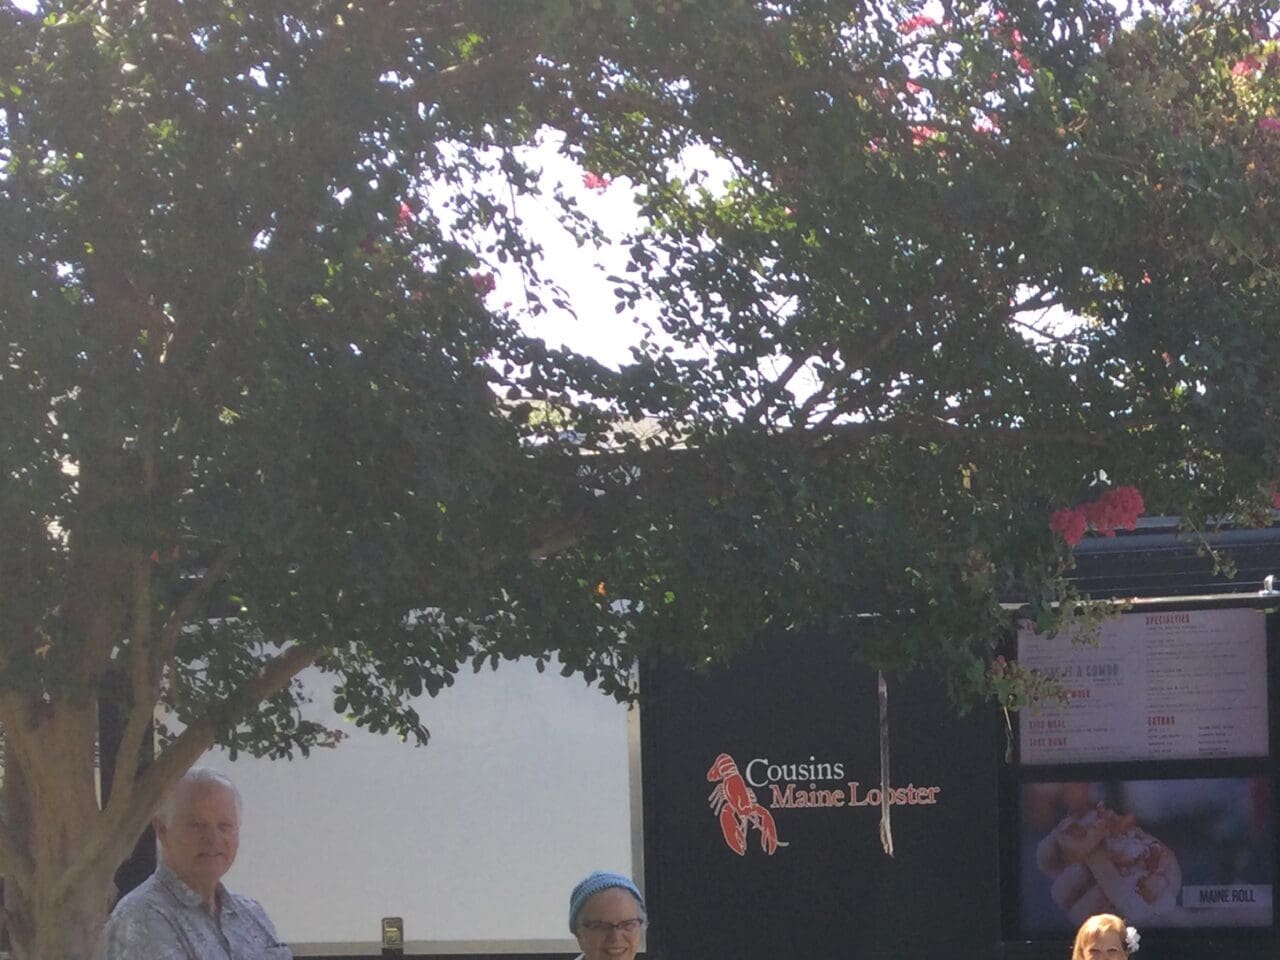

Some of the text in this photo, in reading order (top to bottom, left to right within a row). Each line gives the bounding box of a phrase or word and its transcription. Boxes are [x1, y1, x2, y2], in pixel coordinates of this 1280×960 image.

[746, 756, 845, 787] Cousins
[769, 783, 845, 808] Maine
[1200, 889, 1256, 904] MAINE ROLL
